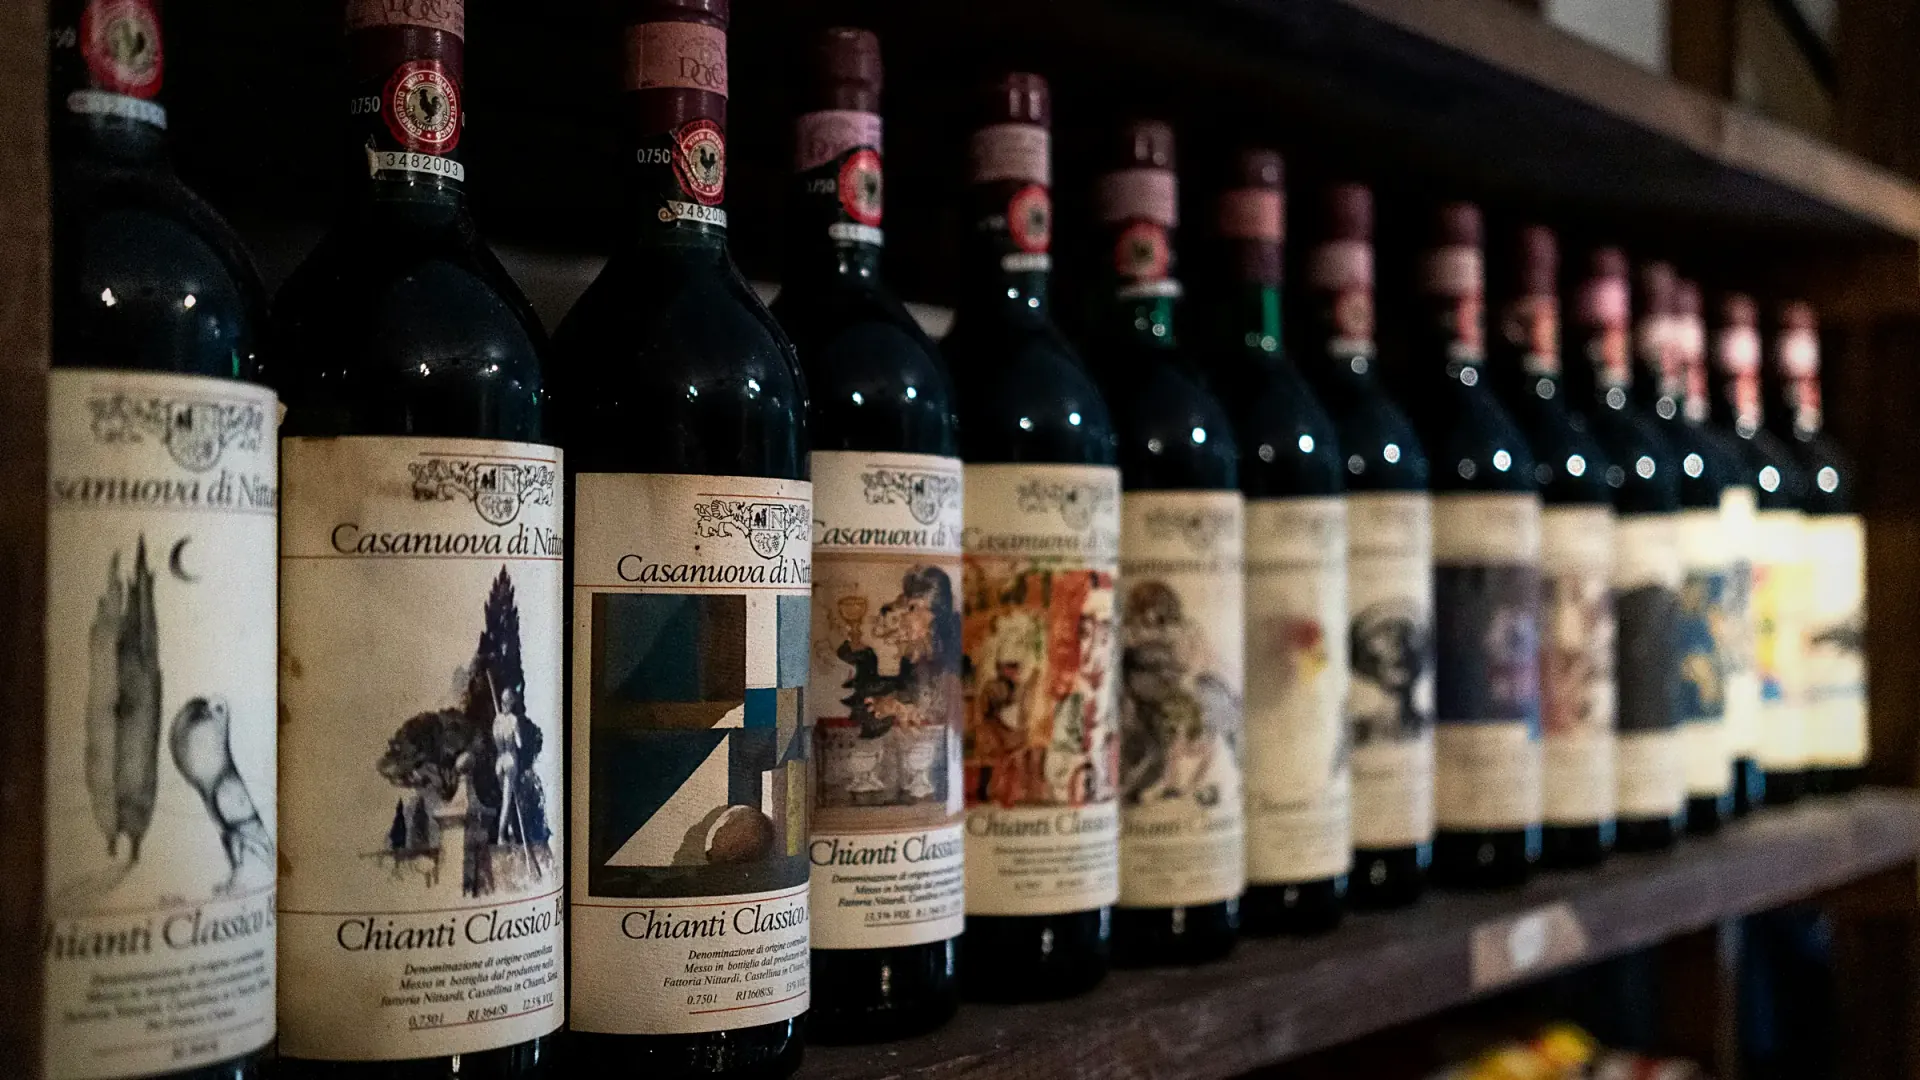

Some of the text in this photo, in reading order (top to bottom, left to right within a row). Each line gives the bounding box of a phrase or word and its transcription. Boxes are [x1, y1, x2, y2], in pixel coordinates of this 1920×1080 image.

[386, 153, 459, 176] 3482003
[637, 149, 670, 164] 0.750
[206, 470, 233, 505] di
[331, 522, 501, 555] Casanuova
[507, 522, 529, 555] di
[617, 553, 765, 584] Casanuova
[769, 554, 788, 584] di
[809, 838, 898, 866] Chianti
[336, 915, 457, 952] Chianti
[464, 906, 551, 945] Classico
[621, 909, 727, 939] Chianti
[733, 902, 805, 935] Classico
[683, 963, 713, 974] Messo
[714, 962, 724, 972] in
[727, 957, 760, 971] bottiglia
[760, 956, 773, 967] dal
[687, 947, 756, 960] Denominazione
[756, 944, 764, 954] di
[764, 942, 787, 954] origine
[663, 977, 701, 988] Fattoria
[703, 973, 742, 986] Nittardi,
[744, 968, 782, 982] Castellina
[781, 967, 788, 976] in
